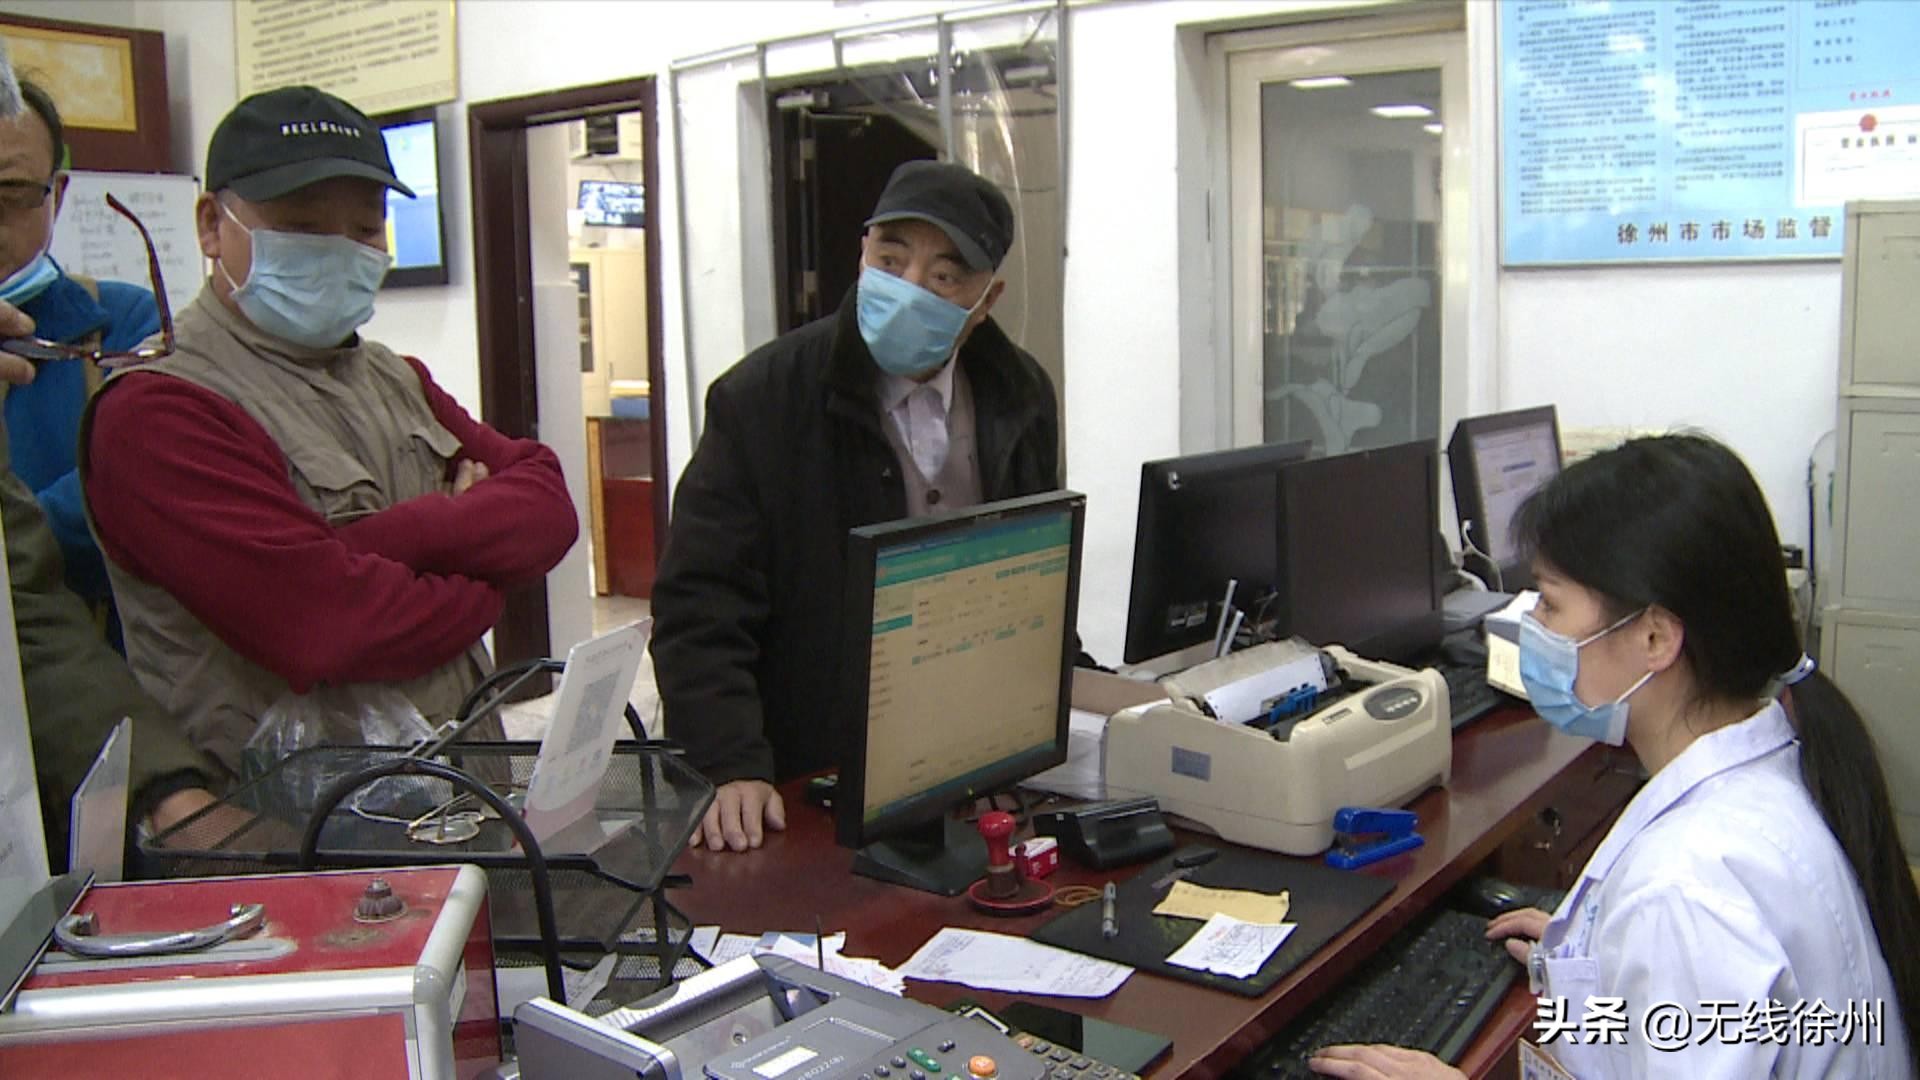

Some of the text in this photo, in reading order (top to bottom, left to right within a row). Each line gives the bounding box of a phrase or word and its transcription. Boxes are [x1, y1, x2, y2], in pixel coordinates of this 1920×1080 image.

[1617, 216, 1832, 244] 徐州市市场监督
